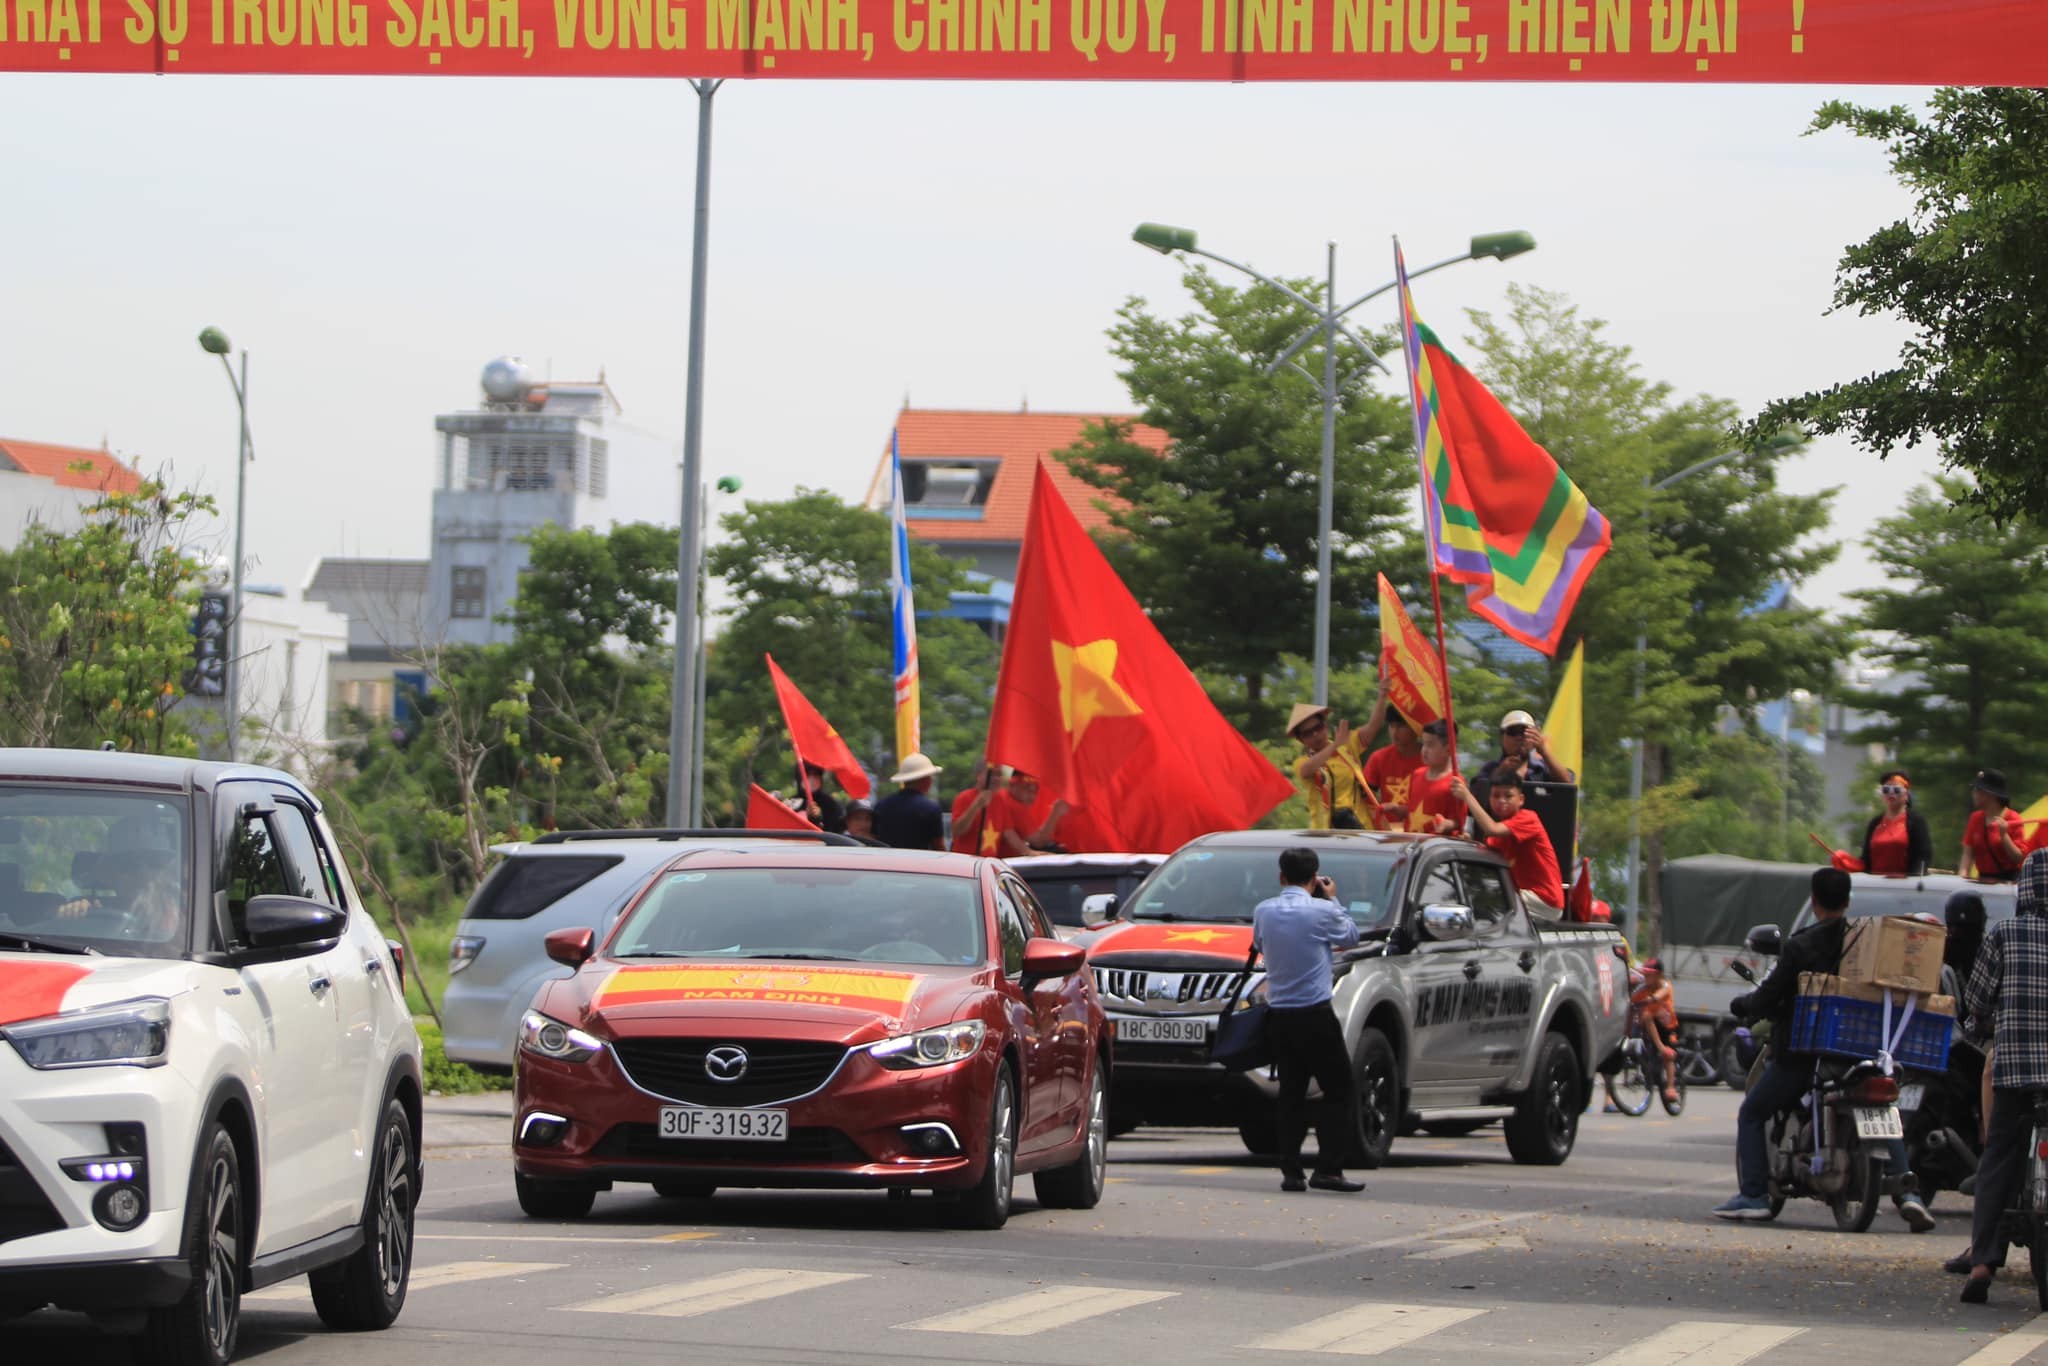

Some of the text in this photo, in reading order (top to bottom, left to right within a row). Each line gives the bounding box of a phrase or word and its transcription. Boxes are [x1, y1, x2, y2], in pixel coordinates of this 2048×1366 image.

[1649, 0, 1738, 70] ĐẠI
[683, 991, 754, 1000] NAM
[1122, 1021, 1203, 1040] 18C-090.90
[664, 1110, 783, 1137] 30F-319.32
